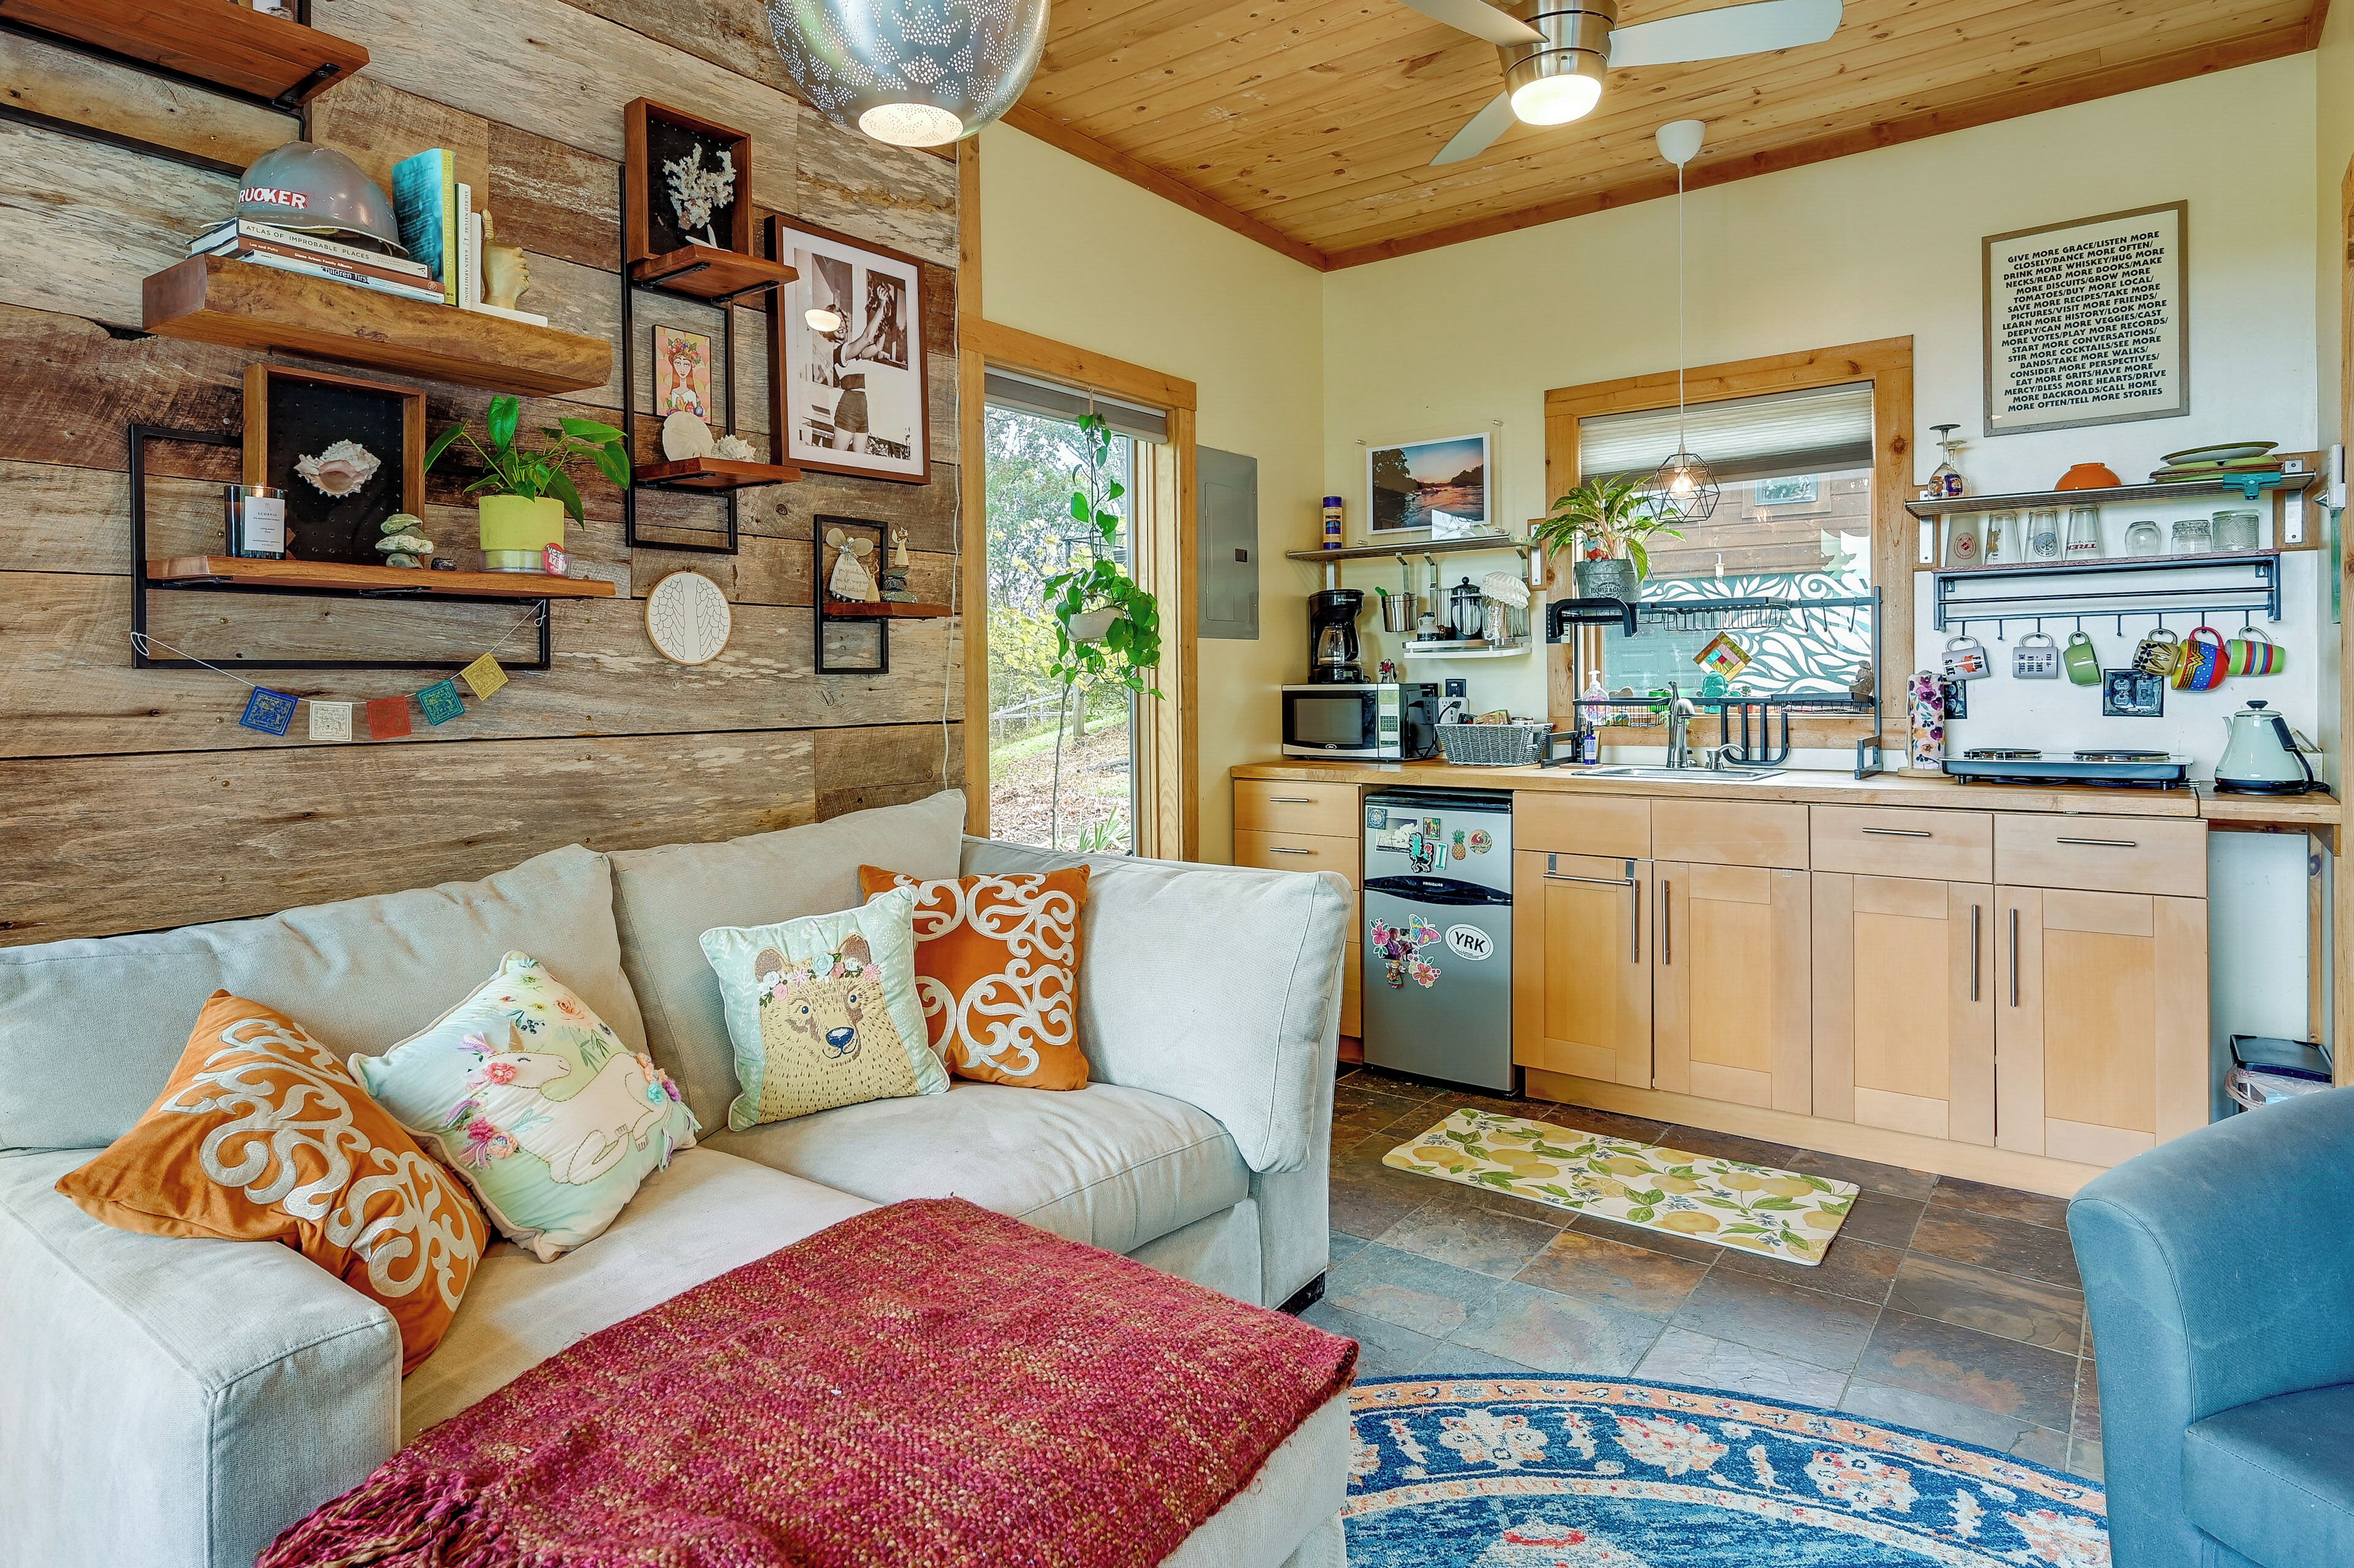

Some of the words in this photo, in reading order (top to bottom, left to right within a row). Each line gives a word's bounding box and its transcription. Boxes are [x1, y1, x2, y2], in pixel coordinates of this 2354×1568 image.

[246, 226, 271, 235] ATLAS
[289, 236, 337, 252] IMPROBABLE
[342, 249, 370, 259] PLACES
[2008, 253, 2029, 263] GIVE
[2032, 248, 2059, 259] MORE
[2062, 237, 2127, 253] GRACE/LISTEN
[2130, 231, 2159, 242] MORE
[2014, 253, 2084, 270] CLOSELY/DANCE
[2087, 247, 2116, 257] MORE
[2119, 240, 2153, 252] OFTEN/
[2004, 270, 2033, 280] DRINK
[2036, 265, 2063, 275] MORE
[2066, 253, 2132, 270] WHISKEY/HUG
[2135, 248, 2165, 258] MORE
[2006, 273, 2062, 288] NECKS/READ
[2065, 268, 2092, 278] MORE
[2016, 285, 2043, 295] MORE
[2122, 268, 2150, 278] MORE
[2089, 281, 2116, 292] MORE
[2120, 275, 2154, 287] LOCAL/
[2008, 303, 2031, 313] SAVE
[2033, 299, 2060, 308] MORE
[2064, 289, 2128, 304] RECIPES/TAKE
[2131, 283, 2160, 294] MORE
[2011, 305, 2079, 320] PICTURES/VISIT
[2082, 300, 2110, 310] MORE
[2114, 292, 2157, 305] FRIENDS/
[2003, 320, 2032, 330] LEARN
[2035, 316, 2062, 325] MORE
[2065, 305, 2135, 321] HISTORY/LOOK
[2138, 300, 2167, 310] MORE
[2008, 324, 2060, 337] DEEPLY/CAN
[2064, 319, 2092, 329] MORE
[2095, 310, 2162, 324] VEGGIES/CAST
[2002, 337, 2028, 347] MORE
[2031, 329, 2085, 342] VOTES/PLAY
[2089, 325, 2117, 334] MORE
[2120, 317, 2168, 330] RECORDS/
[2012, 344, 2039, 354] START
[2042, 340, 2069, 349] MORE
[2073, 327, 2157, 344] CONVERSATIONS/
[2030, 350, 2057, 359] MORE
[2060, 340, 2129, 355] COCKTAILS/SEE
[2133, 336, 2161, 345] MORE
[2081, 351, 2108, 361] MORE
[2112, 346, 2148, 356] WALKS/
[2011, 367, 2055, 378] CONSIDER
[2059, 363, 2086, 372] MORE
[2089, 353, 2160, 368] PERSPECTIVES/
[2035, 375, 2062, 384] MORE
[2065, 367, 2121, 379] GRITS/HAVE
[2124, 363, 2153, 373] MORE
[2065, 379, 2093, 388] MORE
[2097, 370, 2166, 384] HEARTS/DRIVE
[2008, 403, 2035, 412] MORE
[2038, 397, 2089, 408] OFTEN/TELL
[2092, 393, 2120, 402] MORE
[2124, 388, 2163, 398] STORIES
[2013, 394, 2040, 403] MORE
[2128, 380, 2157, 389] HOME
[1455, 931, 1486, 953] YRK
